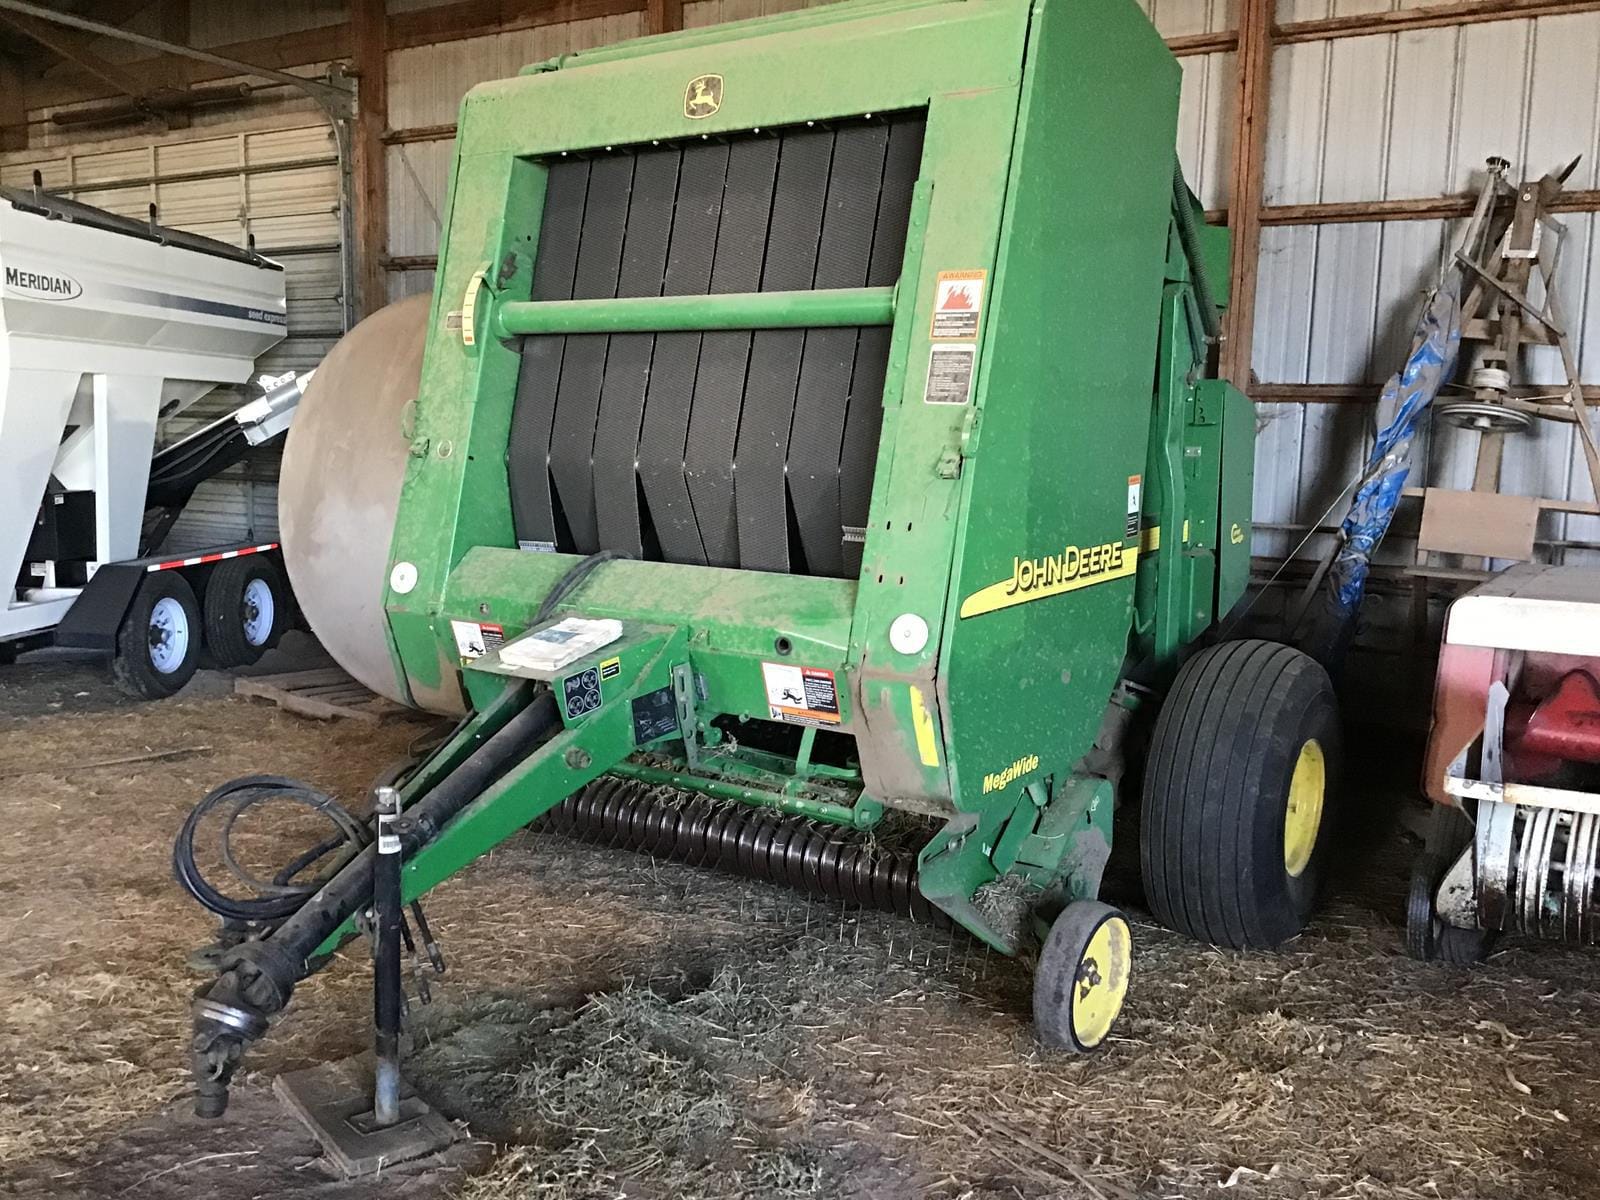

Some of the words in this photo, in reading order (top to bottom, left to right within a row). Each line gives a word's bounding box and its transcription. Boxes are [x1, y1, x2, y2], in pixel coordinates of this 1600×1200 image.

[6, 266, 72, 295] MERIDIAN
[1006, 554, 1063, 596] JOHN
[1062, 541, 1123, 582] DEERE
[982, 753, 1040, 795] MegaWide
